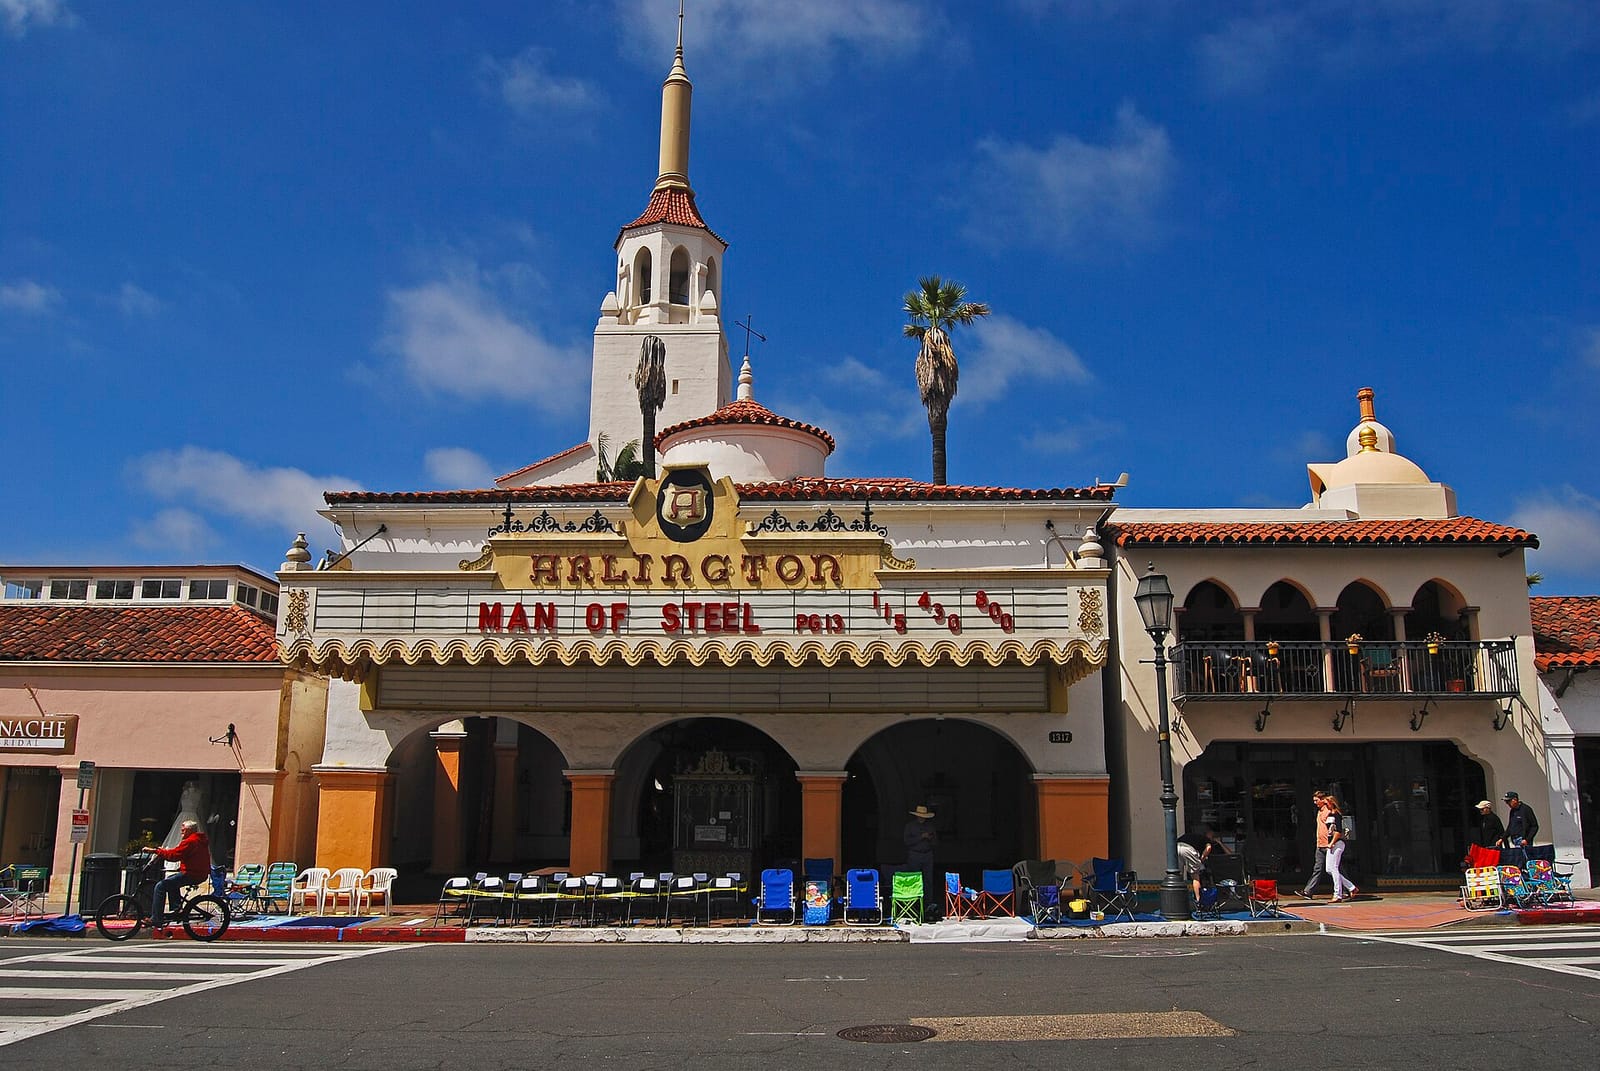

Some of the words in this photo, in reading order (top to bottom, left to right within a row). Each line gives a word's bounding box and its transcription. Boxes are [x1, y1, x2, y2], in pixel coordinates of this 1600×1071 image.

[671, 489, 701, 519] A
[529, 552, 841, 585] ARLINGTON
[478, 602, 556, 632] MAN
[585, 602, 628, 632] OF
[660, 603, 760, 633] STEEL
[1051, 732, 1070, 742] 1317
